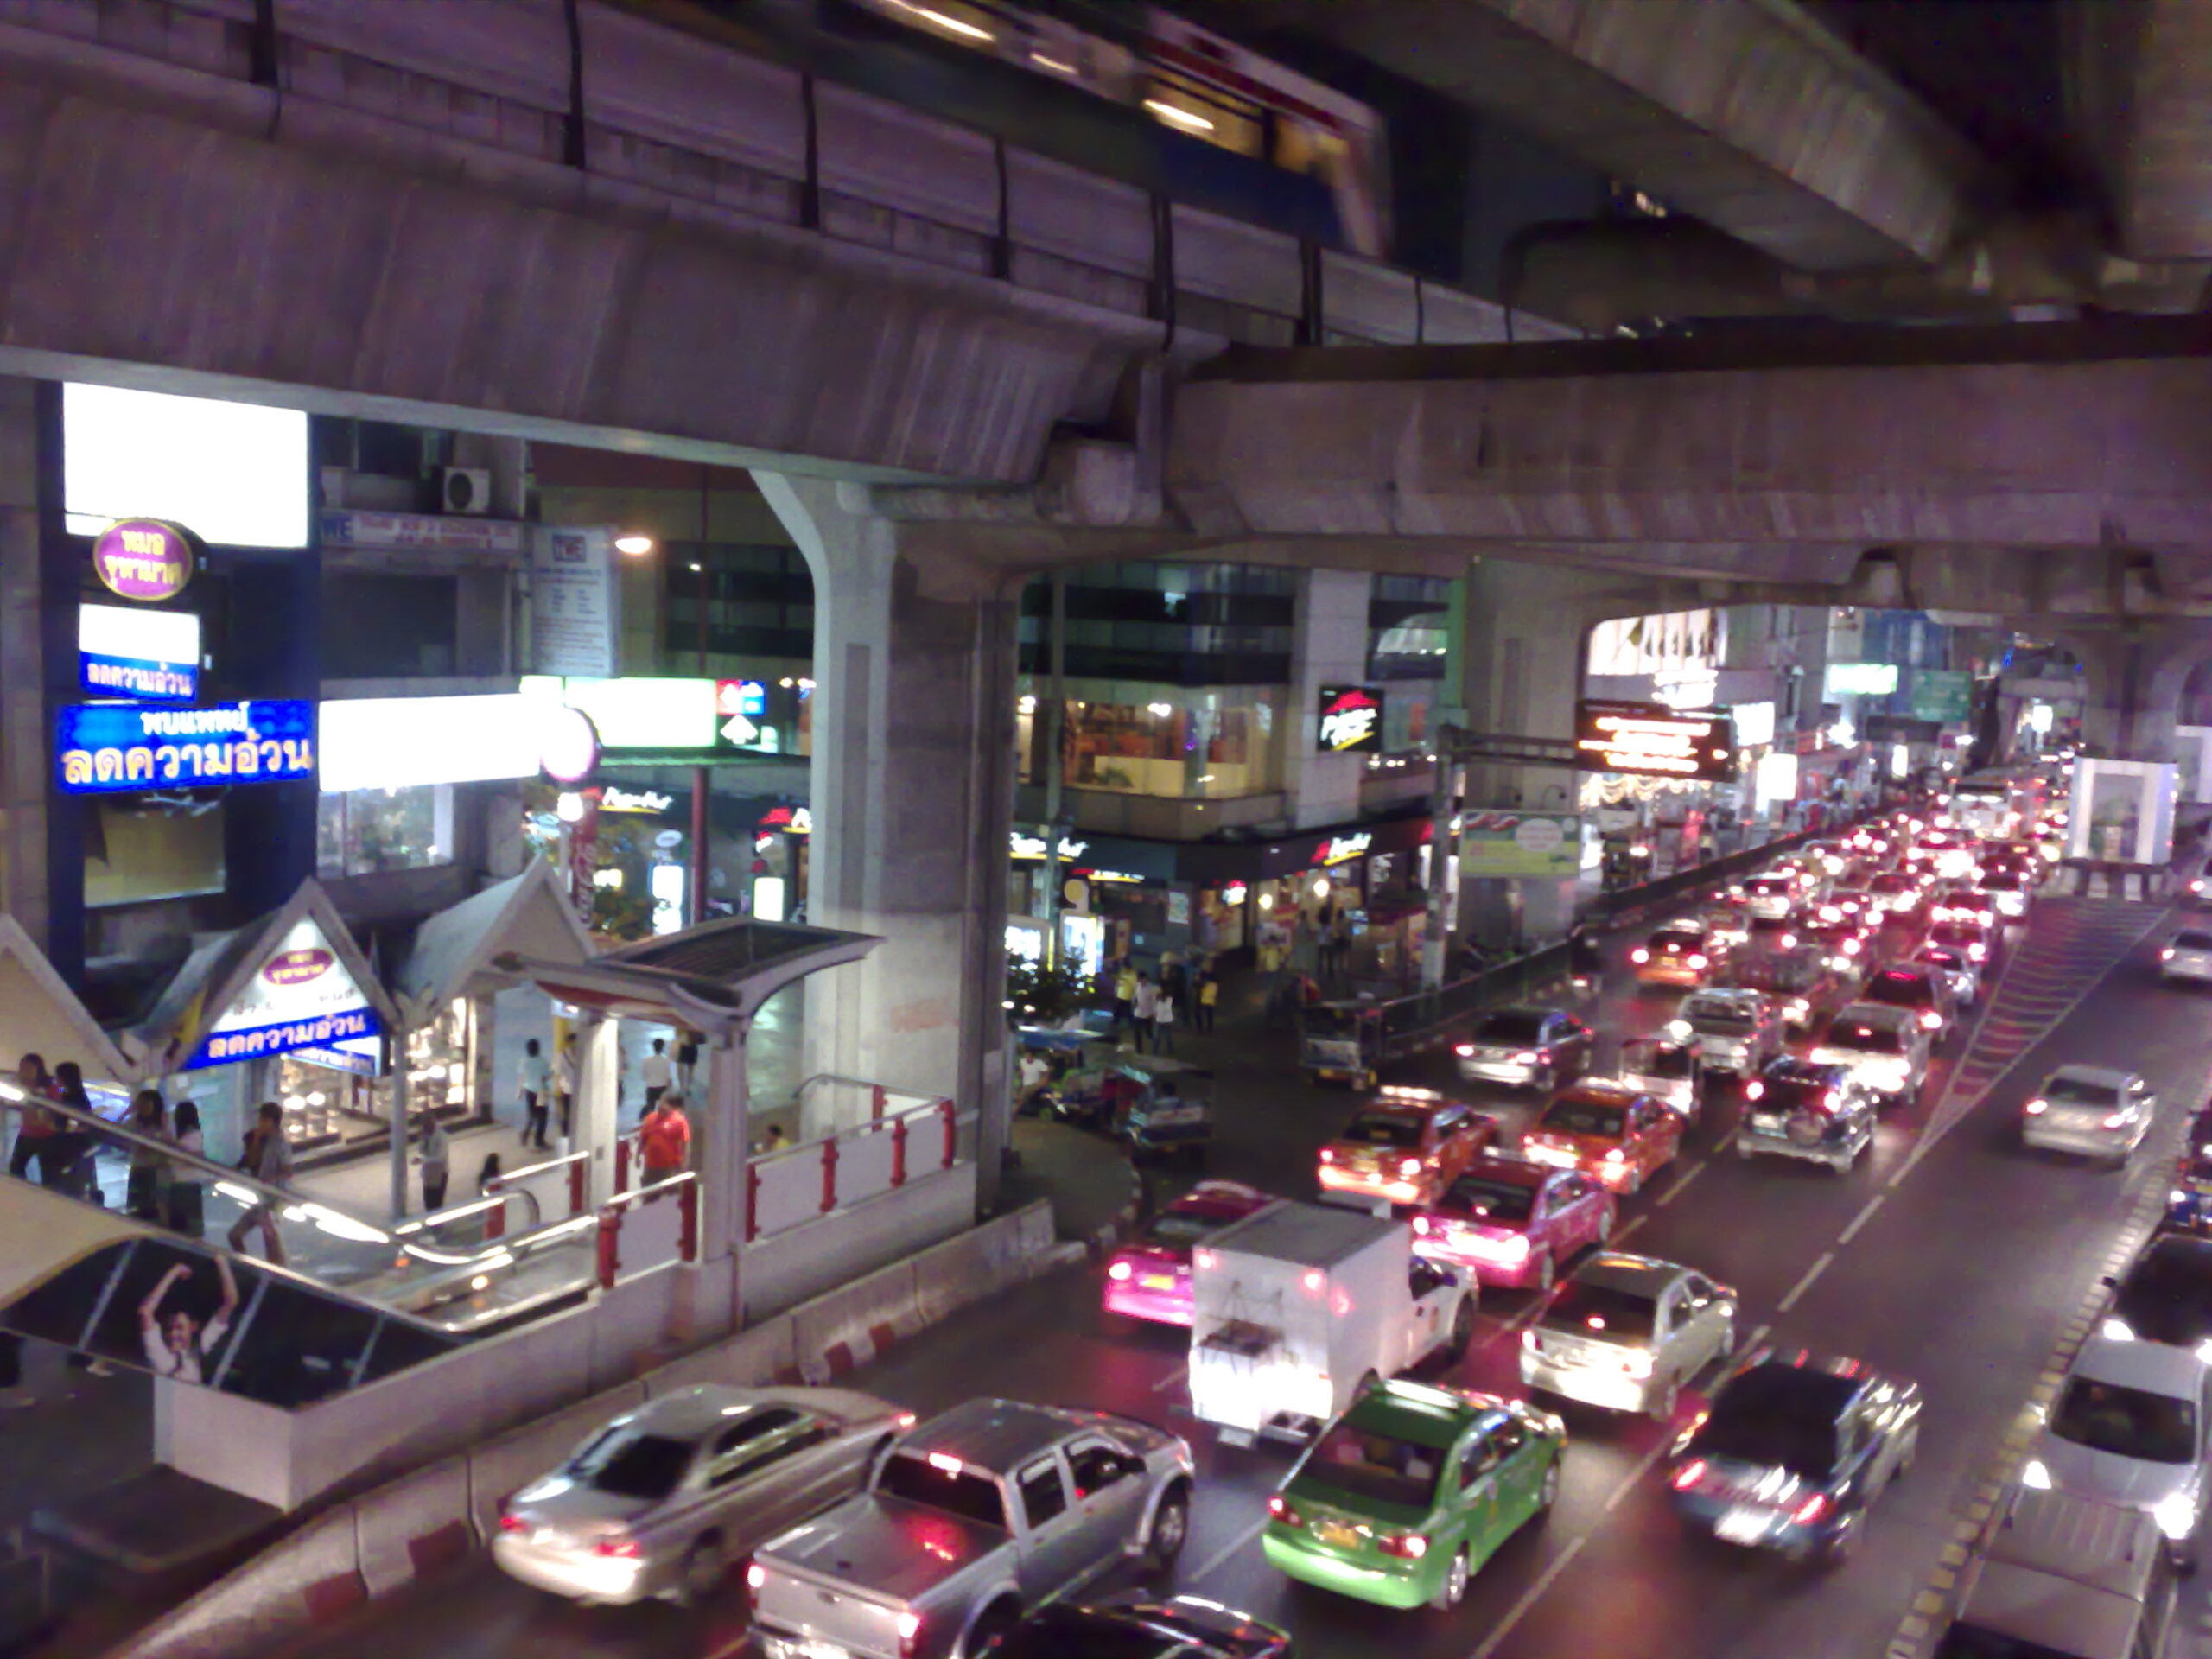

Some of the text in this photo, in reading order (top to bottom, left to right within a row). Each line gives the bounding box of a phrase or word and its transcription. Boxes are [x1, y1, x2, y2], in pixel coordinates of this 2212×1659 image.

[86, 661, 193, 696] ลดความอ้วน
[62, 728, 313, 785] ลดความอ้วน
[207, 1014, 366, 1058] ลดความอ้วน
